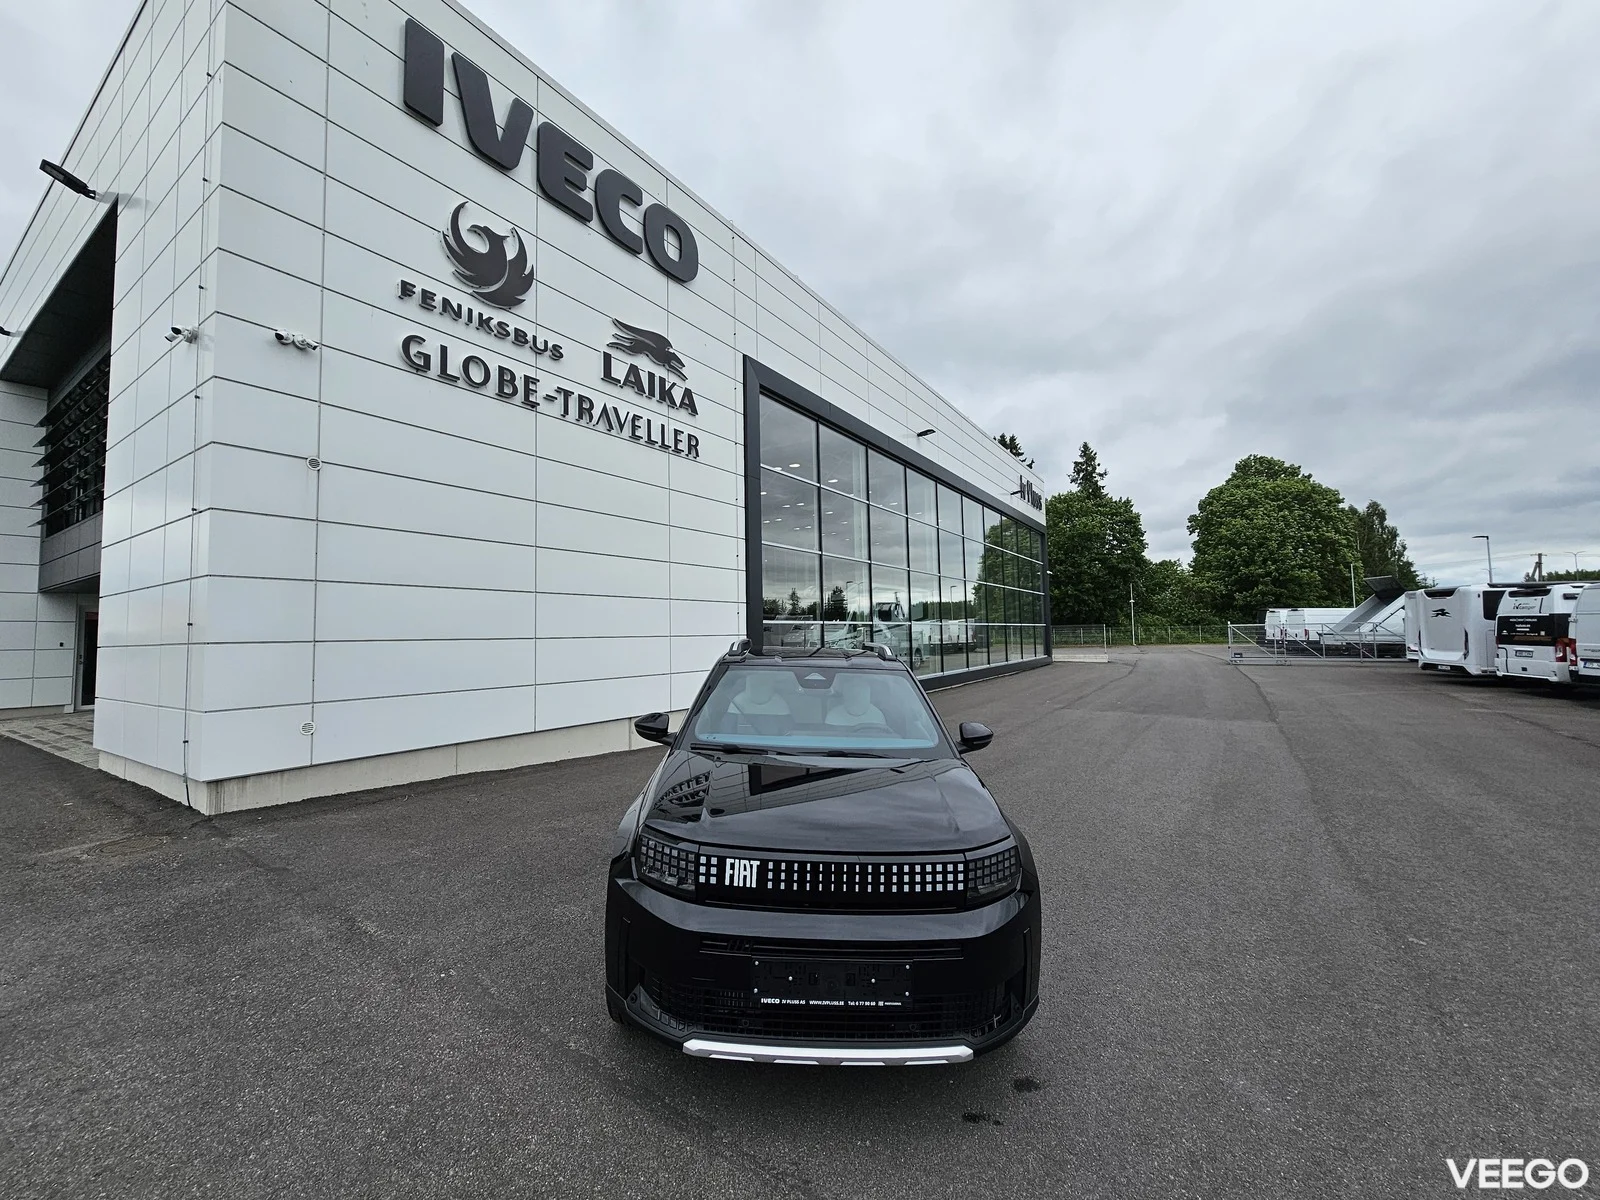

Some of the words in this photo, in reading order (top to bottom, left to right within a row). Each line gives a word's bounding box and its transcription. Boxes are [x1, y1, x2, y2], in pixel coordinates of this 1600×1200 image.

[403, 17, 699, 283] IVECO
[397, 279, 565, 361] FENIKSBUS
[401, 334, 700, 459] GLOBE-TRAVELLER
[600, 350, 699, 417] LAIKA
[725, 858, 760, 888] FIAT
